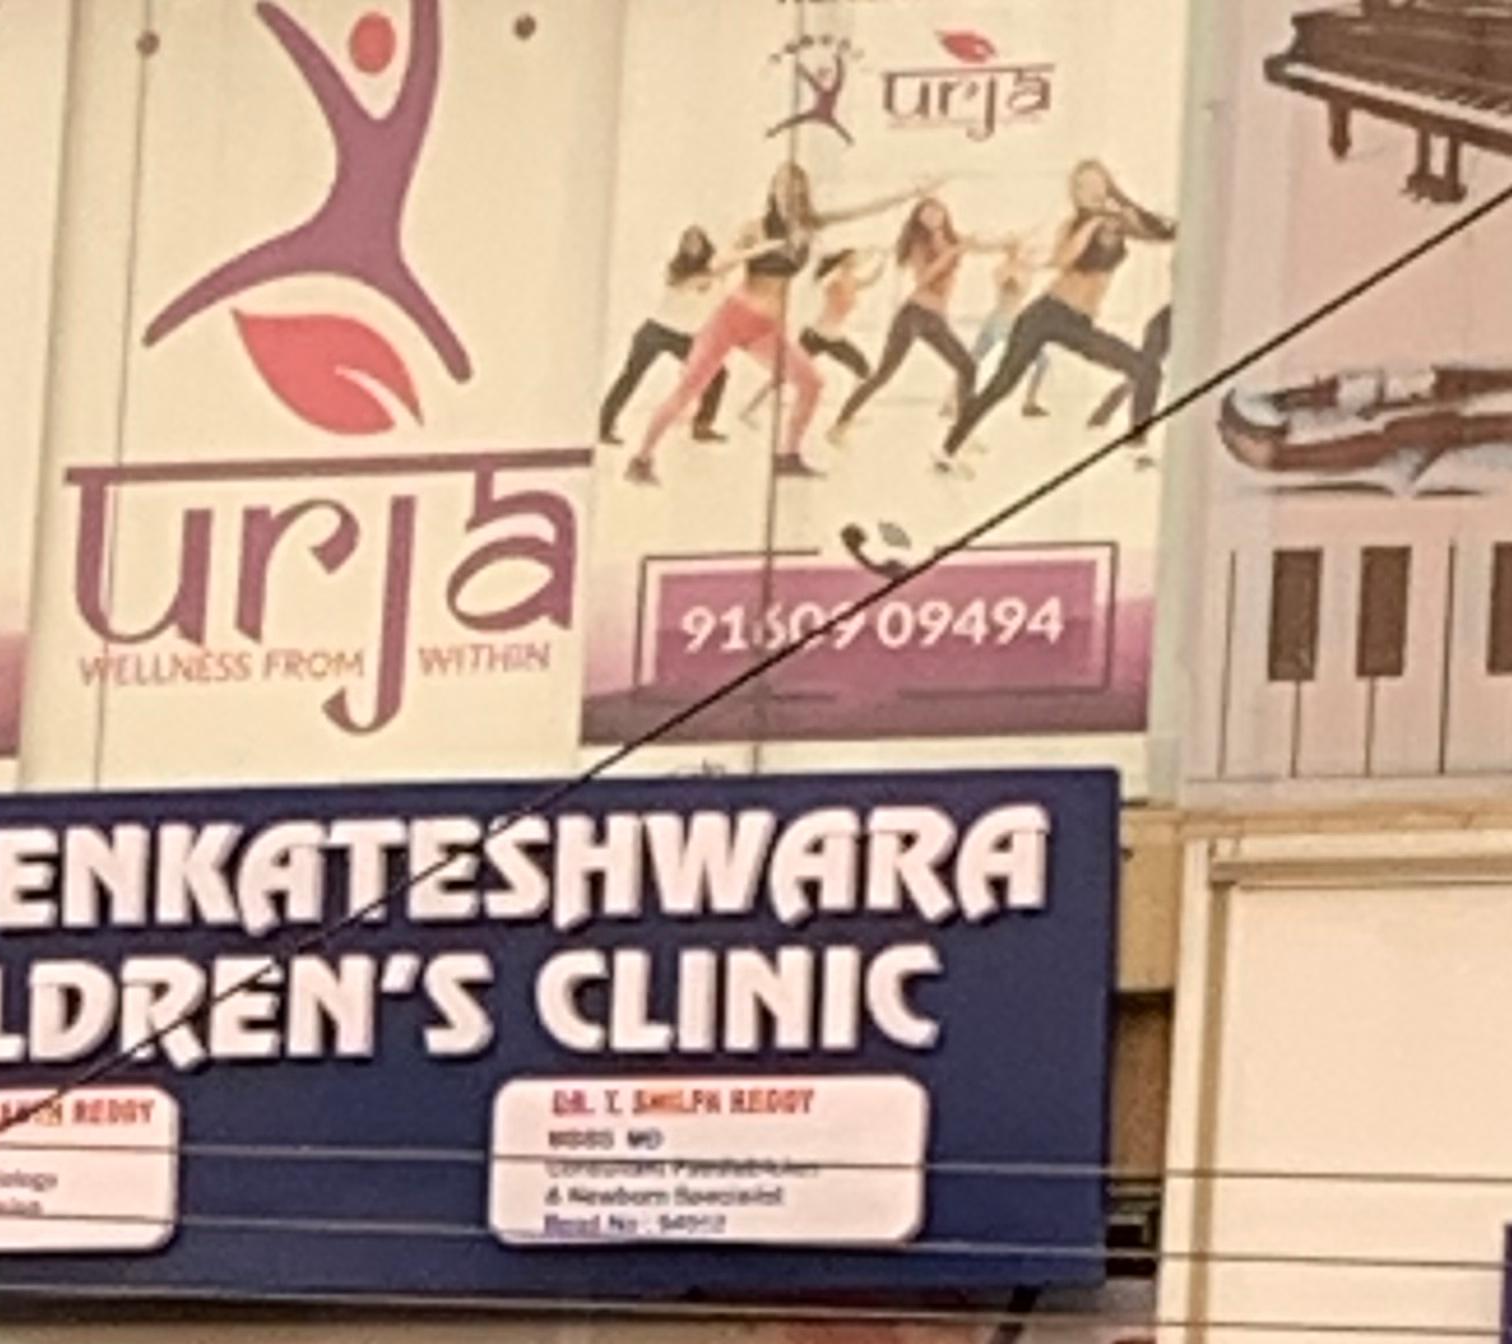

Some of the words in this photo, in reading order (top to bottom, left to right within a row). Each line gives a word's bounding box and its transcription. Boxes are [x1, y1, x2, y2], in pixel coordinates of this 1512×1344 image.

[877, 596, 1063, 648] 09494
[79, 651, 251, 687] WELLNESS
[262, 648, 365, 680] FROM
[418, 643, 551, 676] WITHIN
[534, 944, 942, 1053] CLINIC
